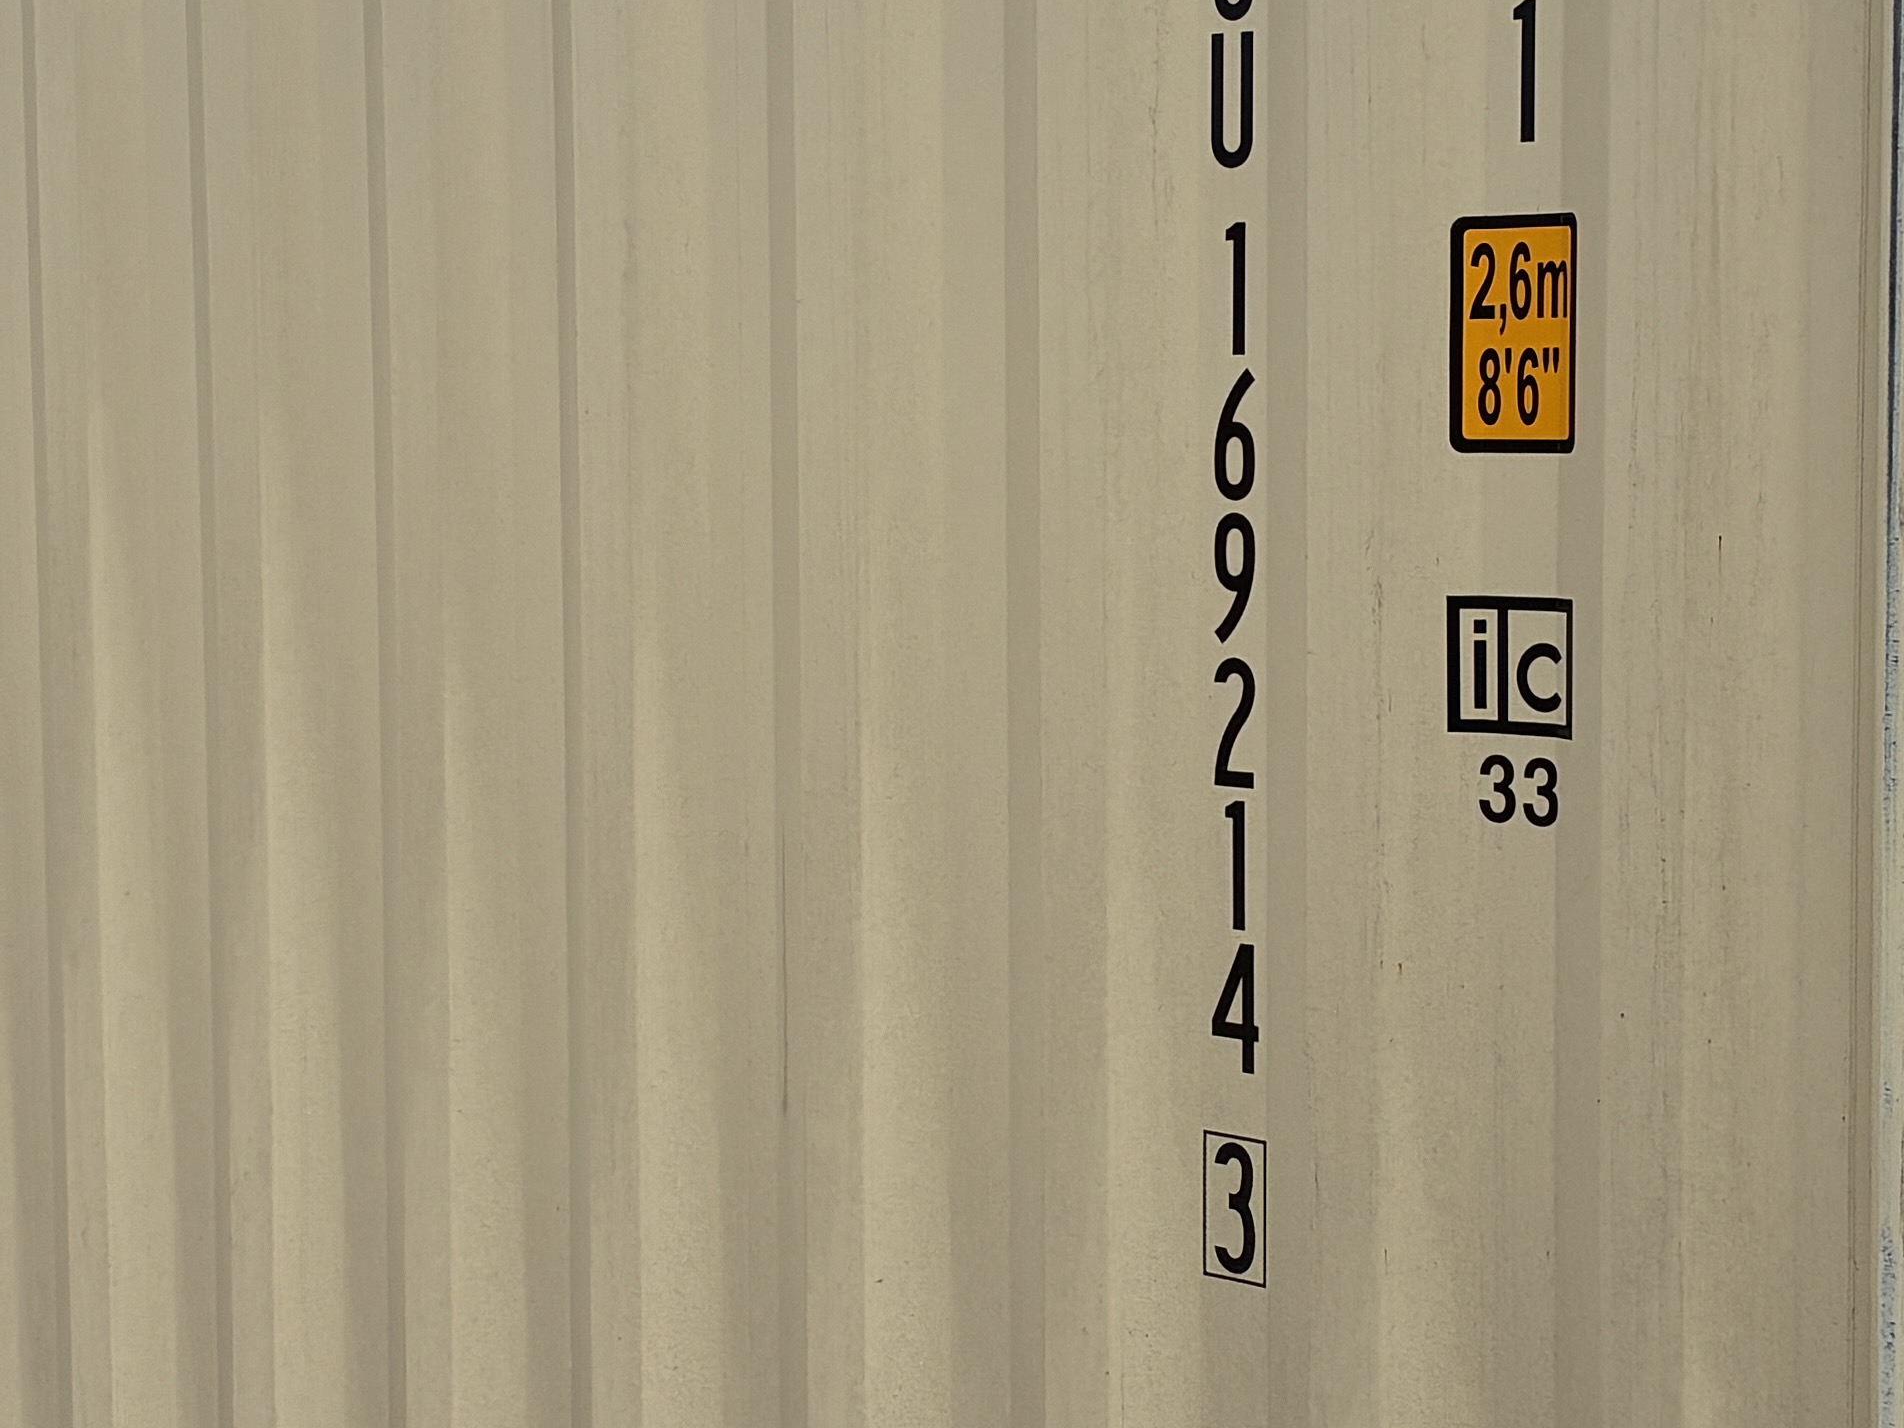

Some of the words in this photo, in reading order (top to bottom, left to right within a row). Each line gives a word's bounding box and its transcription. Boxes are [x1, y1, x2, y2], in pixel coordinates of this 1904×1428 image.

[1468, 242, 1568, 335] 2,6m
[1476, 347, 1560, 426] 8'6"
[1211, 221, 1259, 1075] 169214
[1478, 755, 1559, 828] 33
[1213, 1141, 1256, 1274] 3
